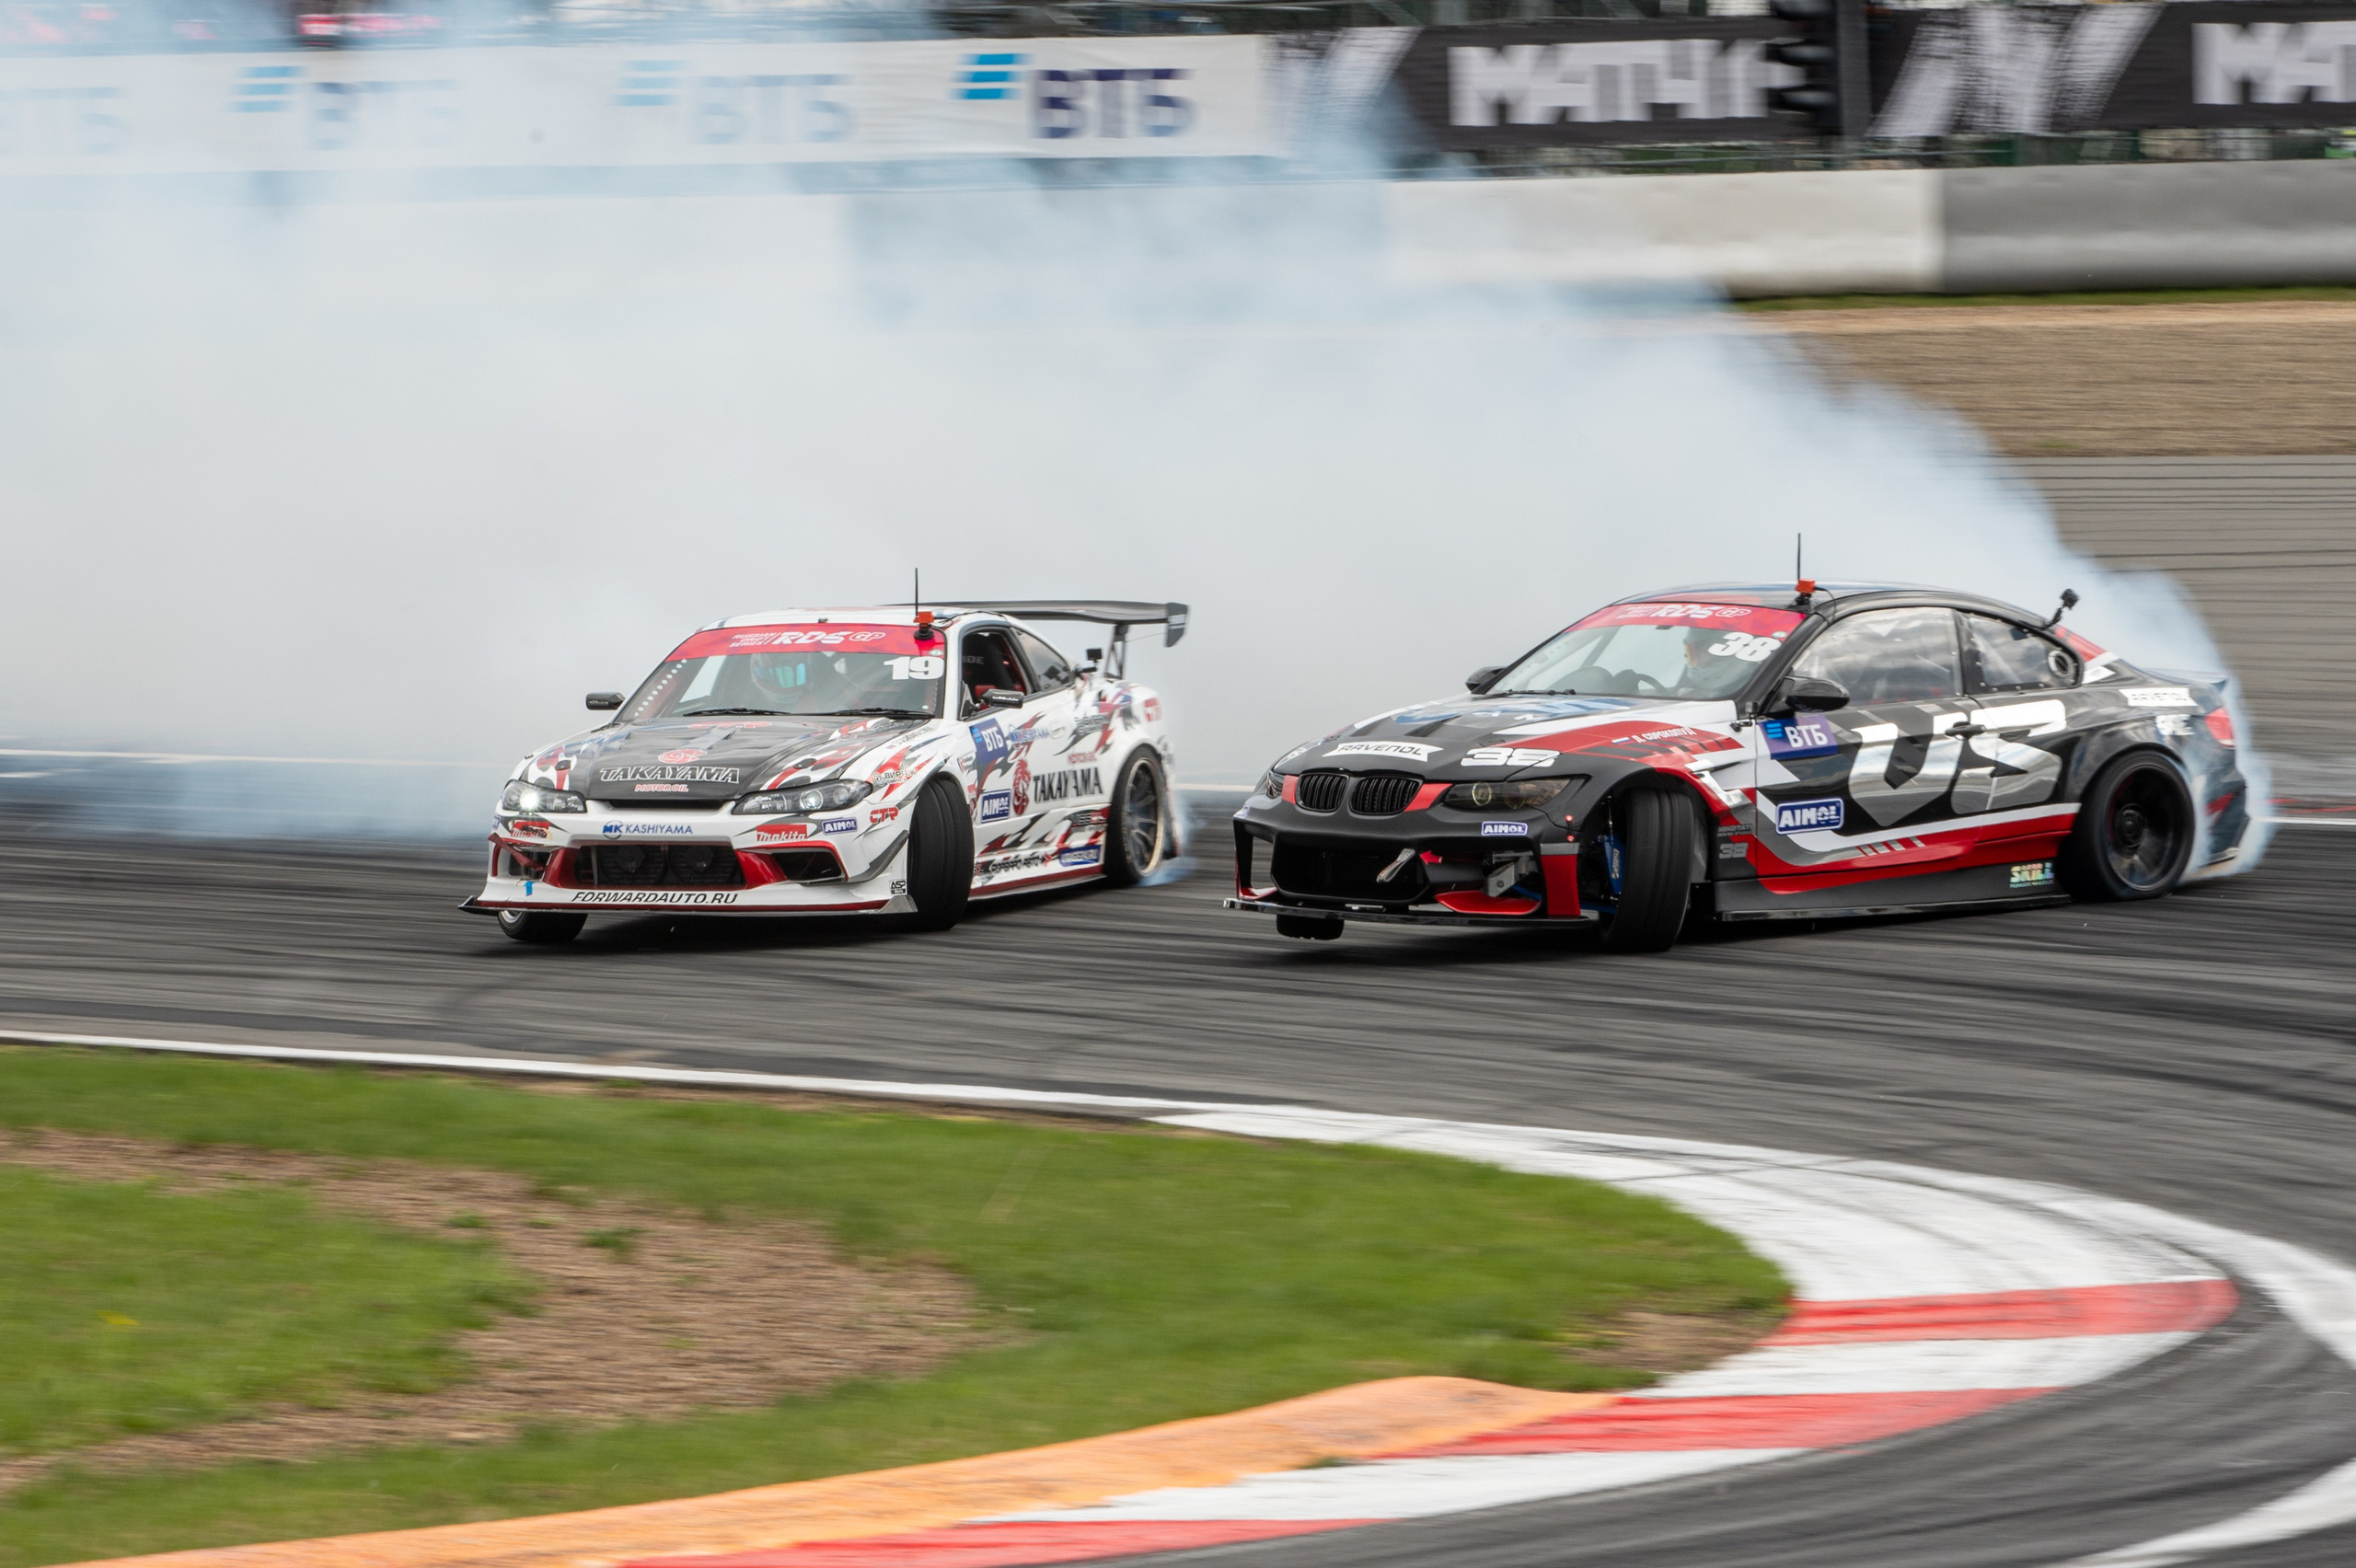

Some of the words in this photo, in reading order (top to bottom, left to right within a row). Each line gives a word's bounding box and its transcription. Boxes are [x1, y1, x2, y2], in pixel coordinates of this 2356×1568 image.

[2191, 21, 2356, 105] МА
[692, 74, 858, 144] ВТБ
[1029, 67, 1198, 139] ВТБ
[0, 86, 133, 155] ТБ
[1649, 604, 1725, 619] RDS
[1715, 607, 1751, 617] GP
[772, 631, 854, 644] RDS
[849, 631, 885, 641] GP
[1707, 631, 1783, 663] 38
[883, 655, 945, 681] 19
[980, 727, 1004, 753] ВТБ
[1784, 723, 1829, 748] ВТБ
[1338, 743, 1423, 755] RAVENOL
[1460, 746, 1561, 767] 38
[600, 766, 740, 784] TAKAYAMA
[1033, 767, 1103, 803] TAKAYAMA
[635, 783, 672, 792] MOTOR
[672, 784, 689, 792] OIL
[870, 806, 899, 824] CTR
[982, 797, 1010, 817] AIMOL
[1779, 805, 1841, 828] AIMOL
[603, 824, 624, 834] MK
[625, 824, 693, 835] KASHIYAMA
[825, 820, 856, 833] AIMOL
[1484, 824, 1524, 834] AIMOL
[1719, 842, 1749, 859] 38
[571, 892, 738, 905] FORWARDAUTO.RU
